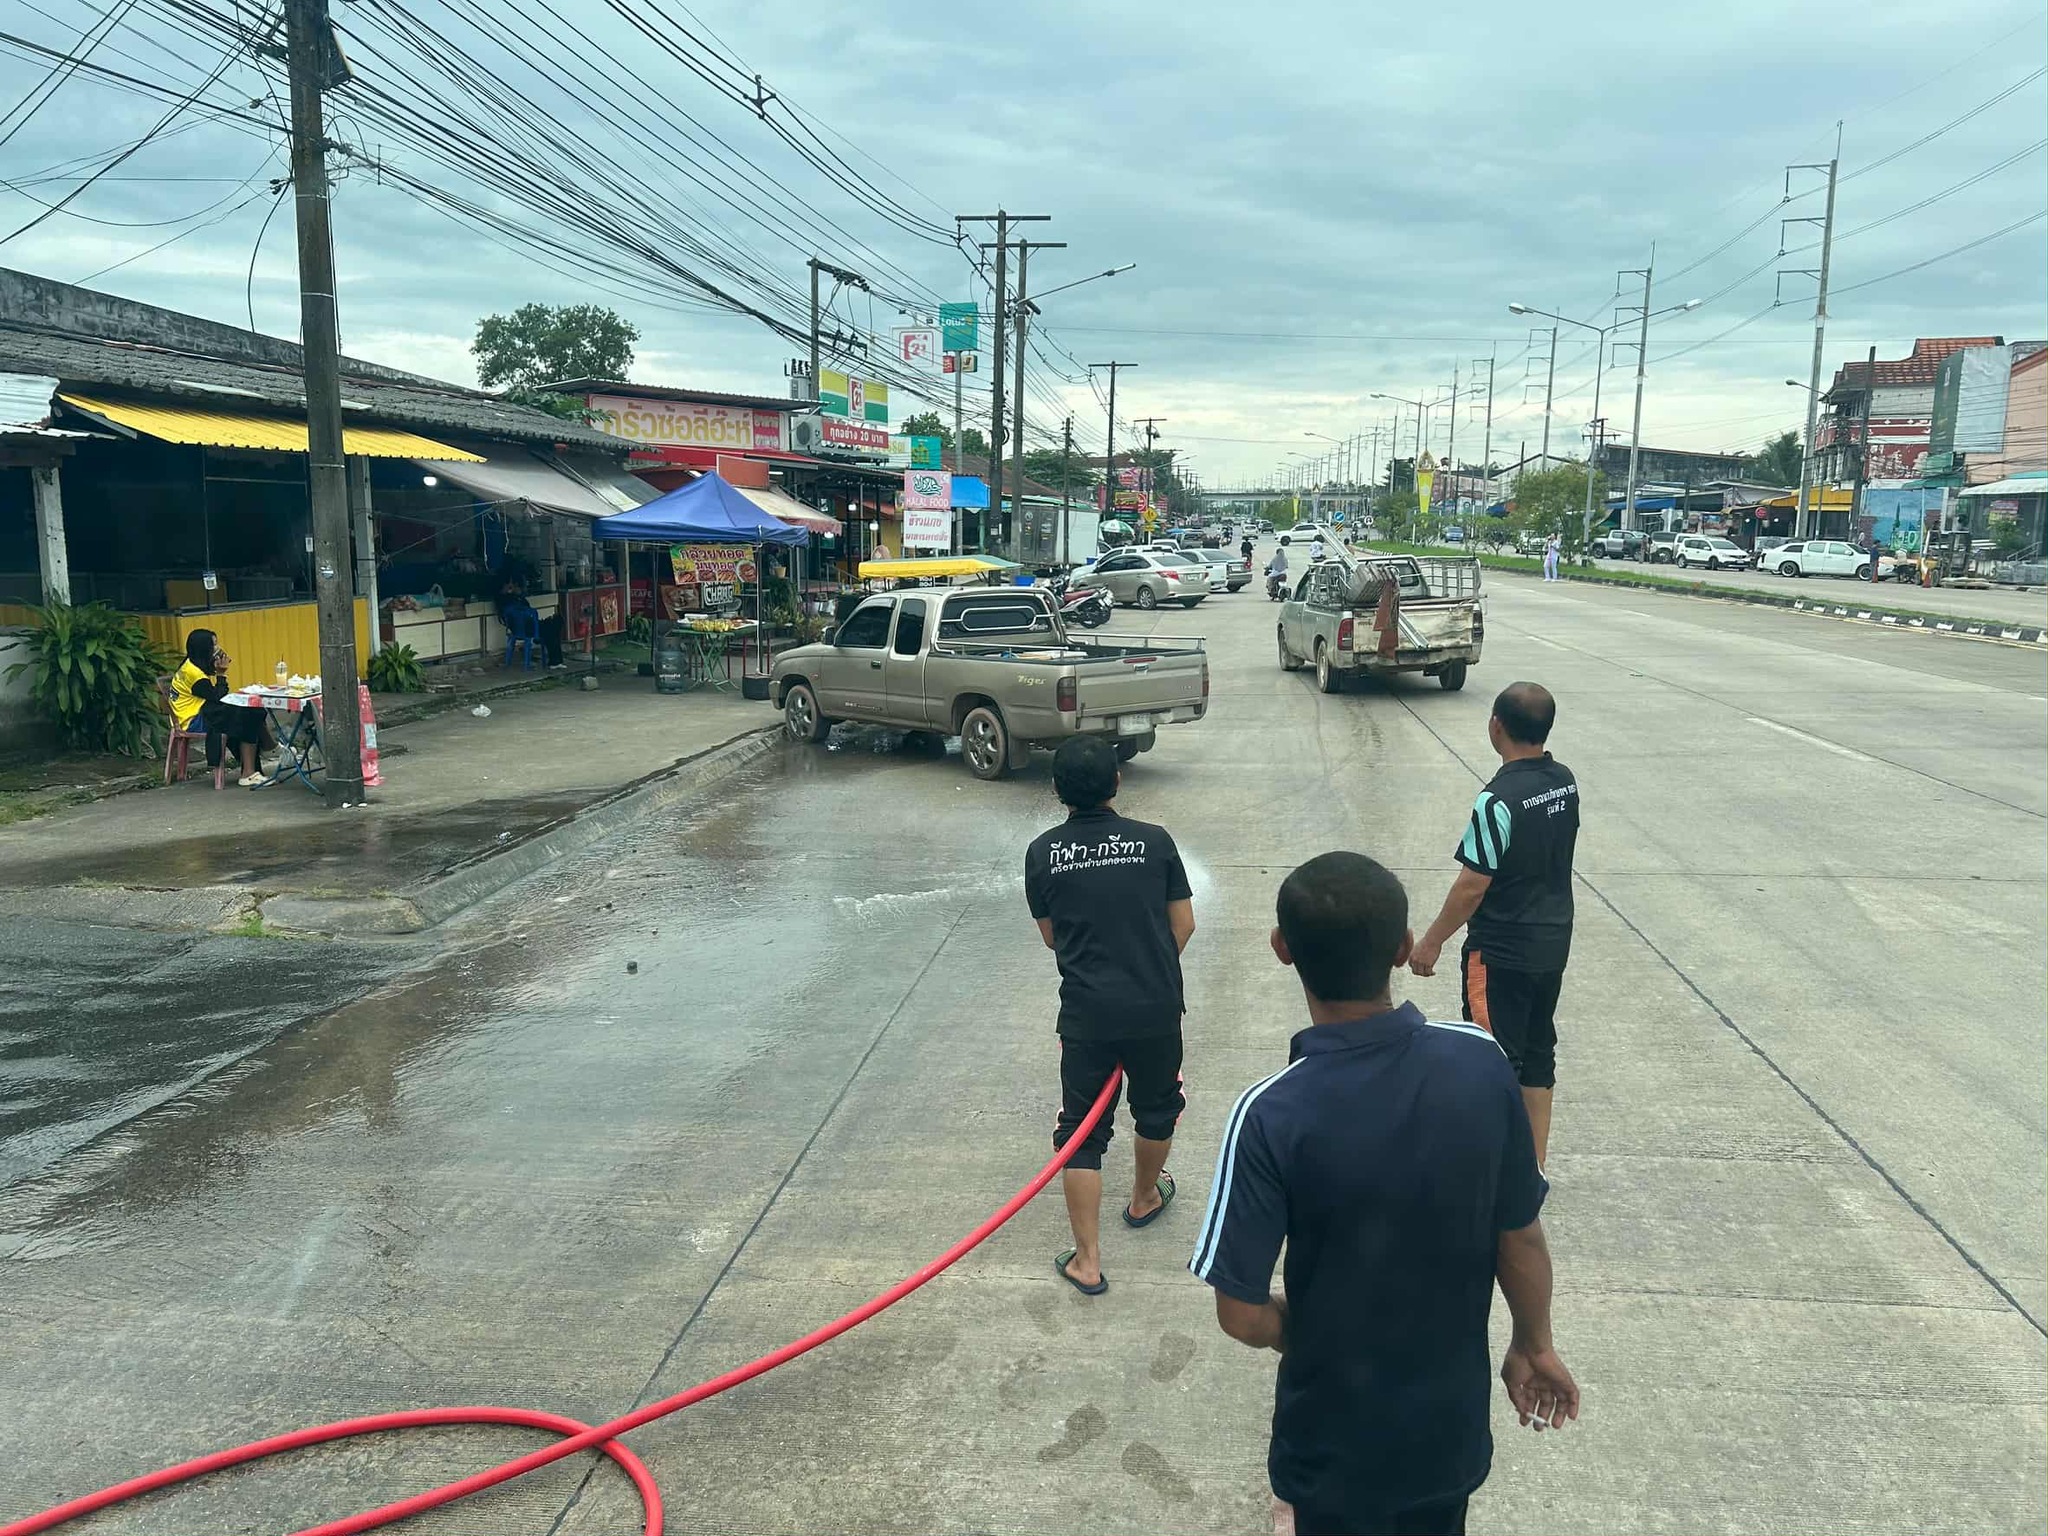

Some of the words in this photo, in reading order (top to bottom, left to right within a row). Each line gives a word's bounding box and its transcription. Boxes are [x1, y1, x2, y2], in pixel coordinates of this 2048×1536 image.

[860, 430, 869, 442] 20
[871, 433, 884, 444] บาท
[906, 497, 927, 507] HALAL
[929, 497, 949, 507] FOOD
[680, 547, 745, 560] กล้วยทอด
[695, 559, 736, 571] มันทอด
[1017, 675, 1047, 686] Tiger
[1546, 799, 1560, 819] รุ่นที่
[1560, 800, 1566, 811] 2
[1050, 834, 1146, 865] กีฬา-กรีฑา
